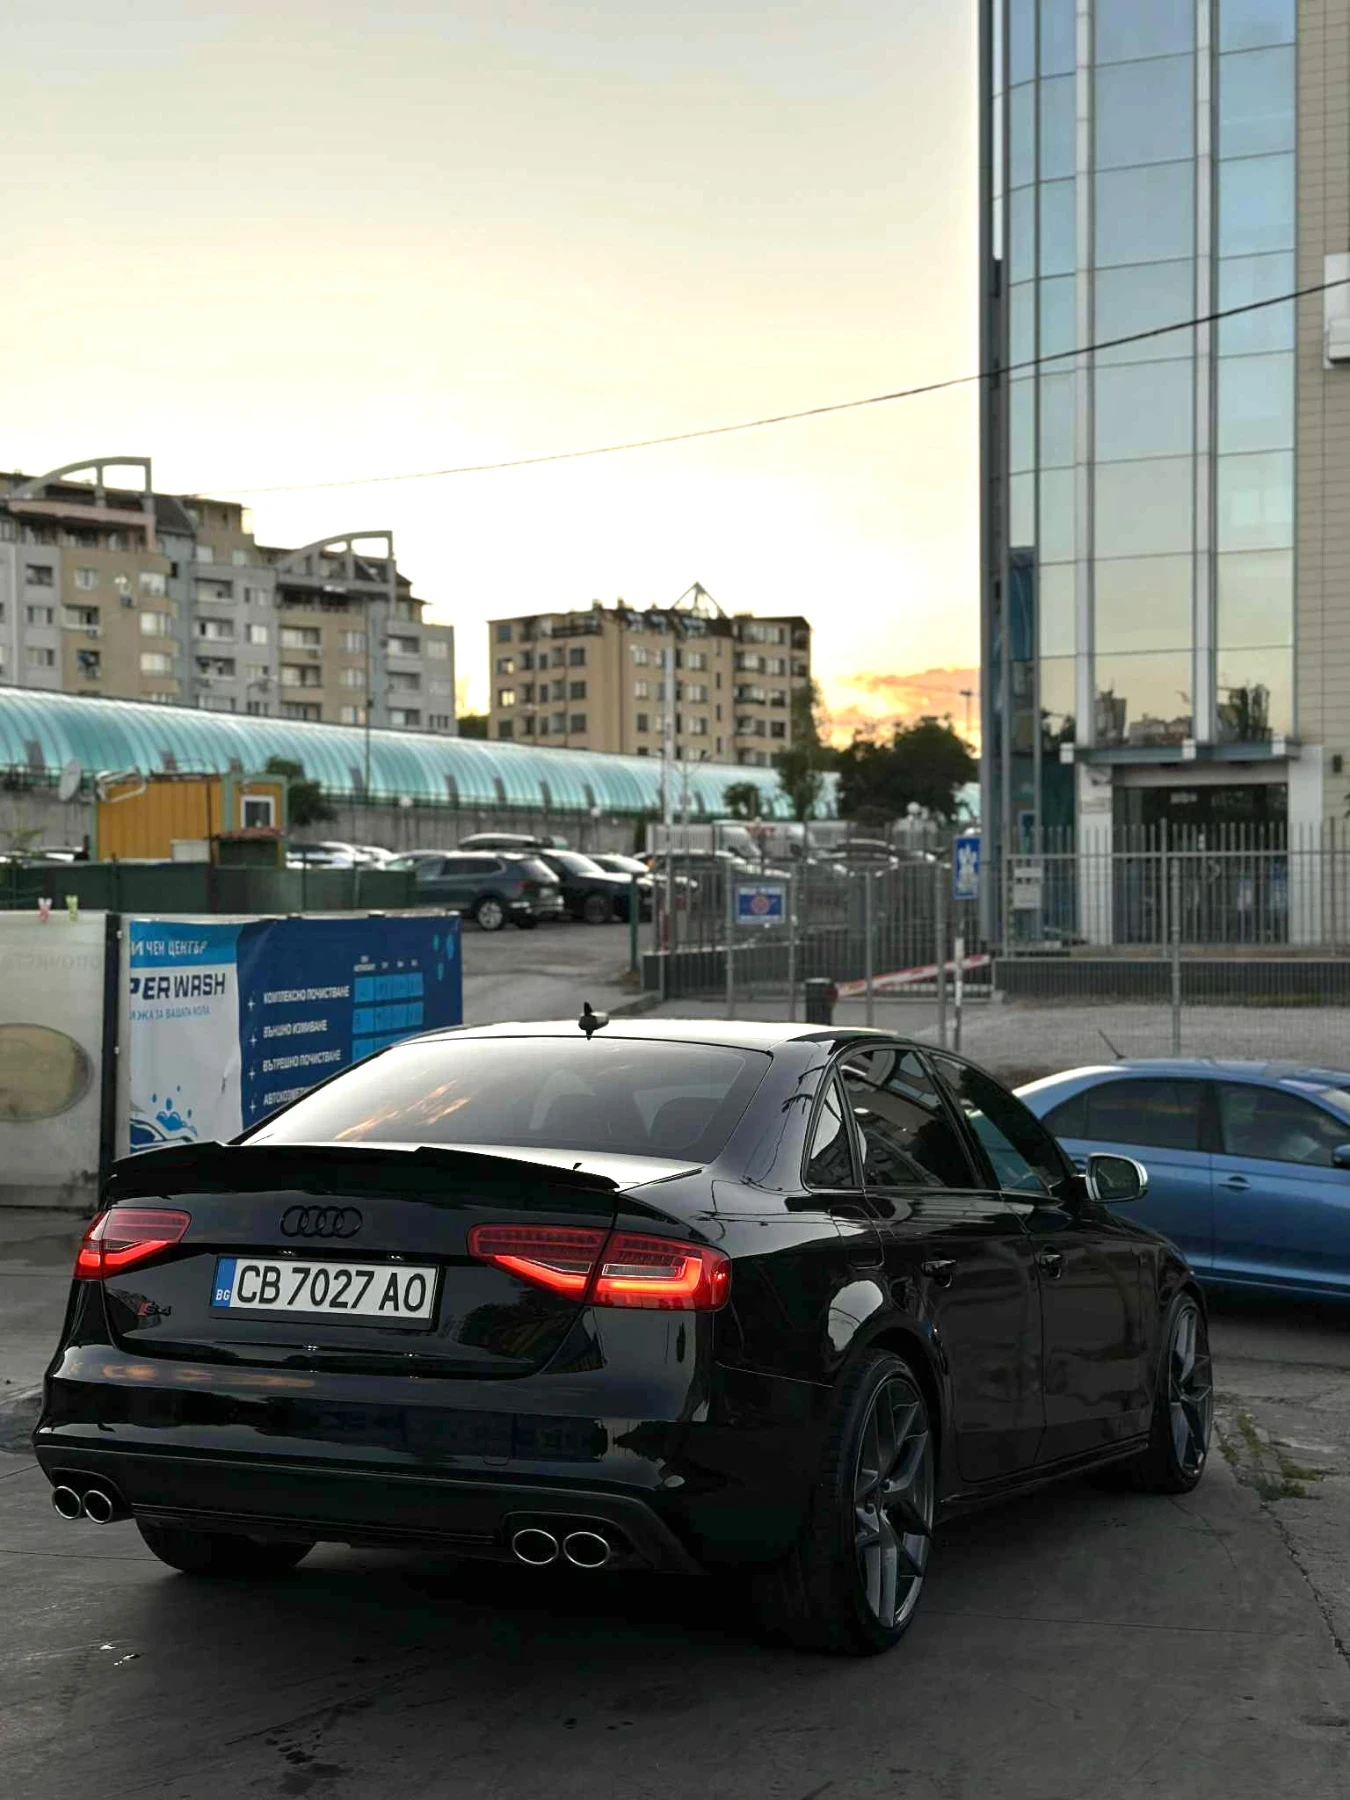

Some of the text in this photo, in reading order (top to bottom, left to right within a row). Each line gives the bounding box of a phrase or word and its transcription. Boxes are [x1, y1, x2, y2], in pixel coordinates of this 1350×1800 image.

[168, 940, 209, 958] ЦЕНТЪР
[174, 972, 226, 999] WASH
[263, 985, 350, 1004] КОМПЛЕКСНО ПОЧИСТВАНЕ
[263, 1019, 328, 1039] ВЪНШНО ИЗМИВАНЕ
[263, 1049, 342, 1072] ВЪТРЕШНО ПОЧИСТВАНЕ
[216, 1289, 231, 1301] BG
[237, 1265, 427, 1313] CB 7027 AO
